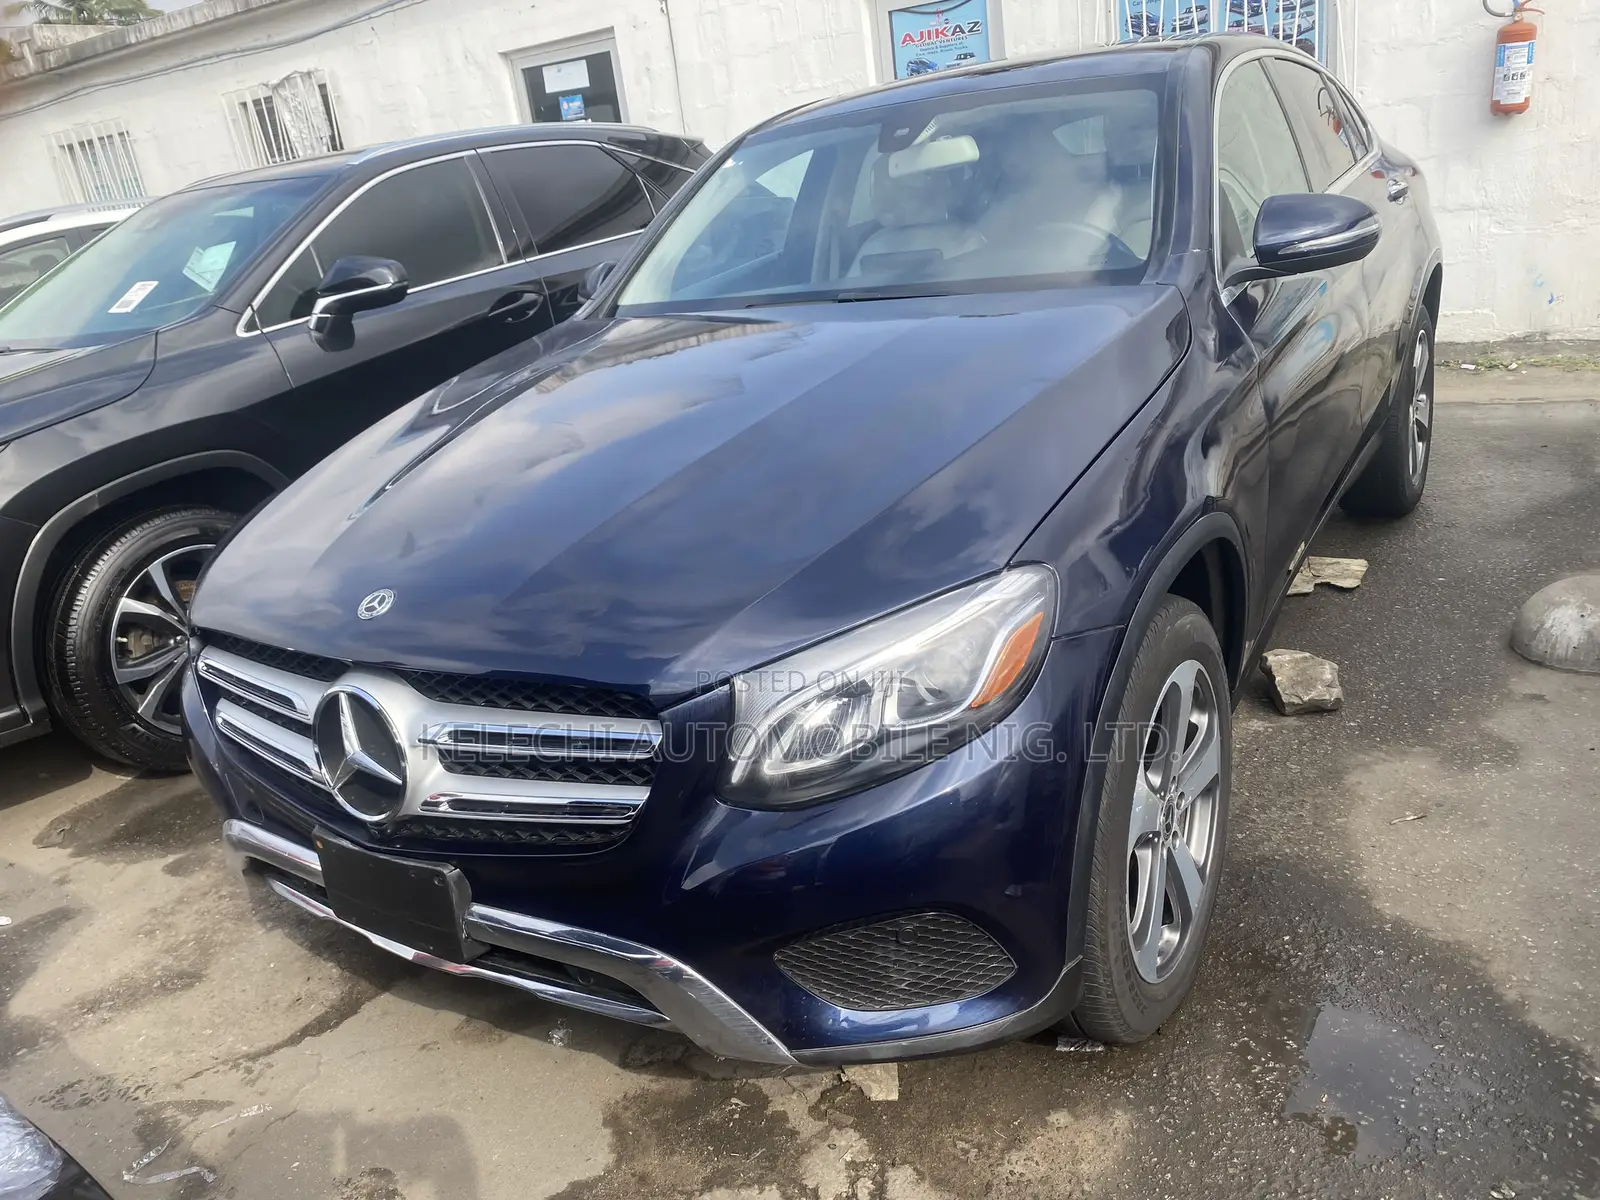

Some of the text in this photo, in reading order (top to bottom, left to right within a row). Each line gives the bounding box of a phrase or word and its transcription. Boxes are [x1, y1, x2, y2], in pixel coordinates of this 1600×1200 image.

[901, 20, 981, 45] AJIKAZ
[915, 36, 968, 48] GLOBAL VENTURES
